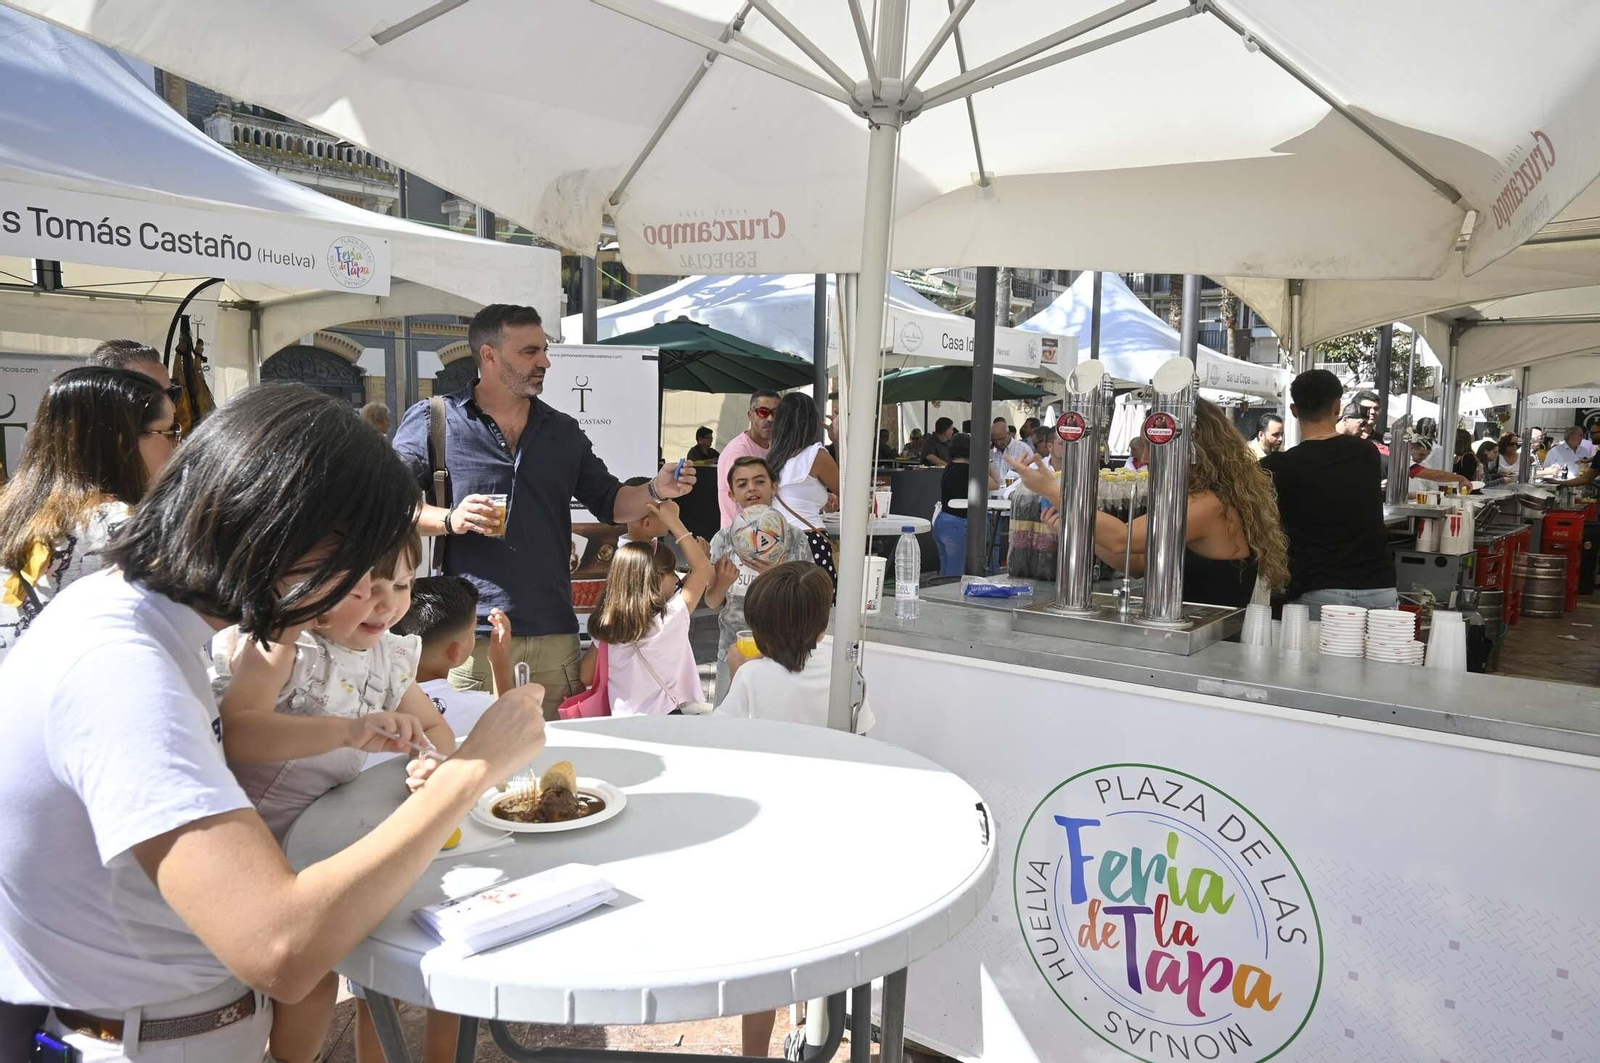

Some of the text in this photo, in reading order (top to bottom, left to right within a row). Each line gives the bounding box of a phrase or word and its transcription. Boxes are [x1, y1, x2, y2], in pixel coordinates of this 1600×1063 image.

[26, 205, 132, 247] Tomás
[139, 221, 252, 261] Castaño
[257, 246, 316, 270] (Huelva)
[334, 246, 363, 262] Feria
[343, 260, 370, 278] Tapa
[942, 332, 964, 351] Casa
[1541, 396, 1564, 404] Casa
[1566, 396, 1586, 404] Lalo
[1053, 814, 1236, 915] Feria
[1025, 860, 1074, 982] HUELVA
[1077, 893, 1200, 951] de la
[1095, 775, 1308, 1061] PLAZA DE LAS MONJAS
[1102, 905, 1283, 1018] Tapa
